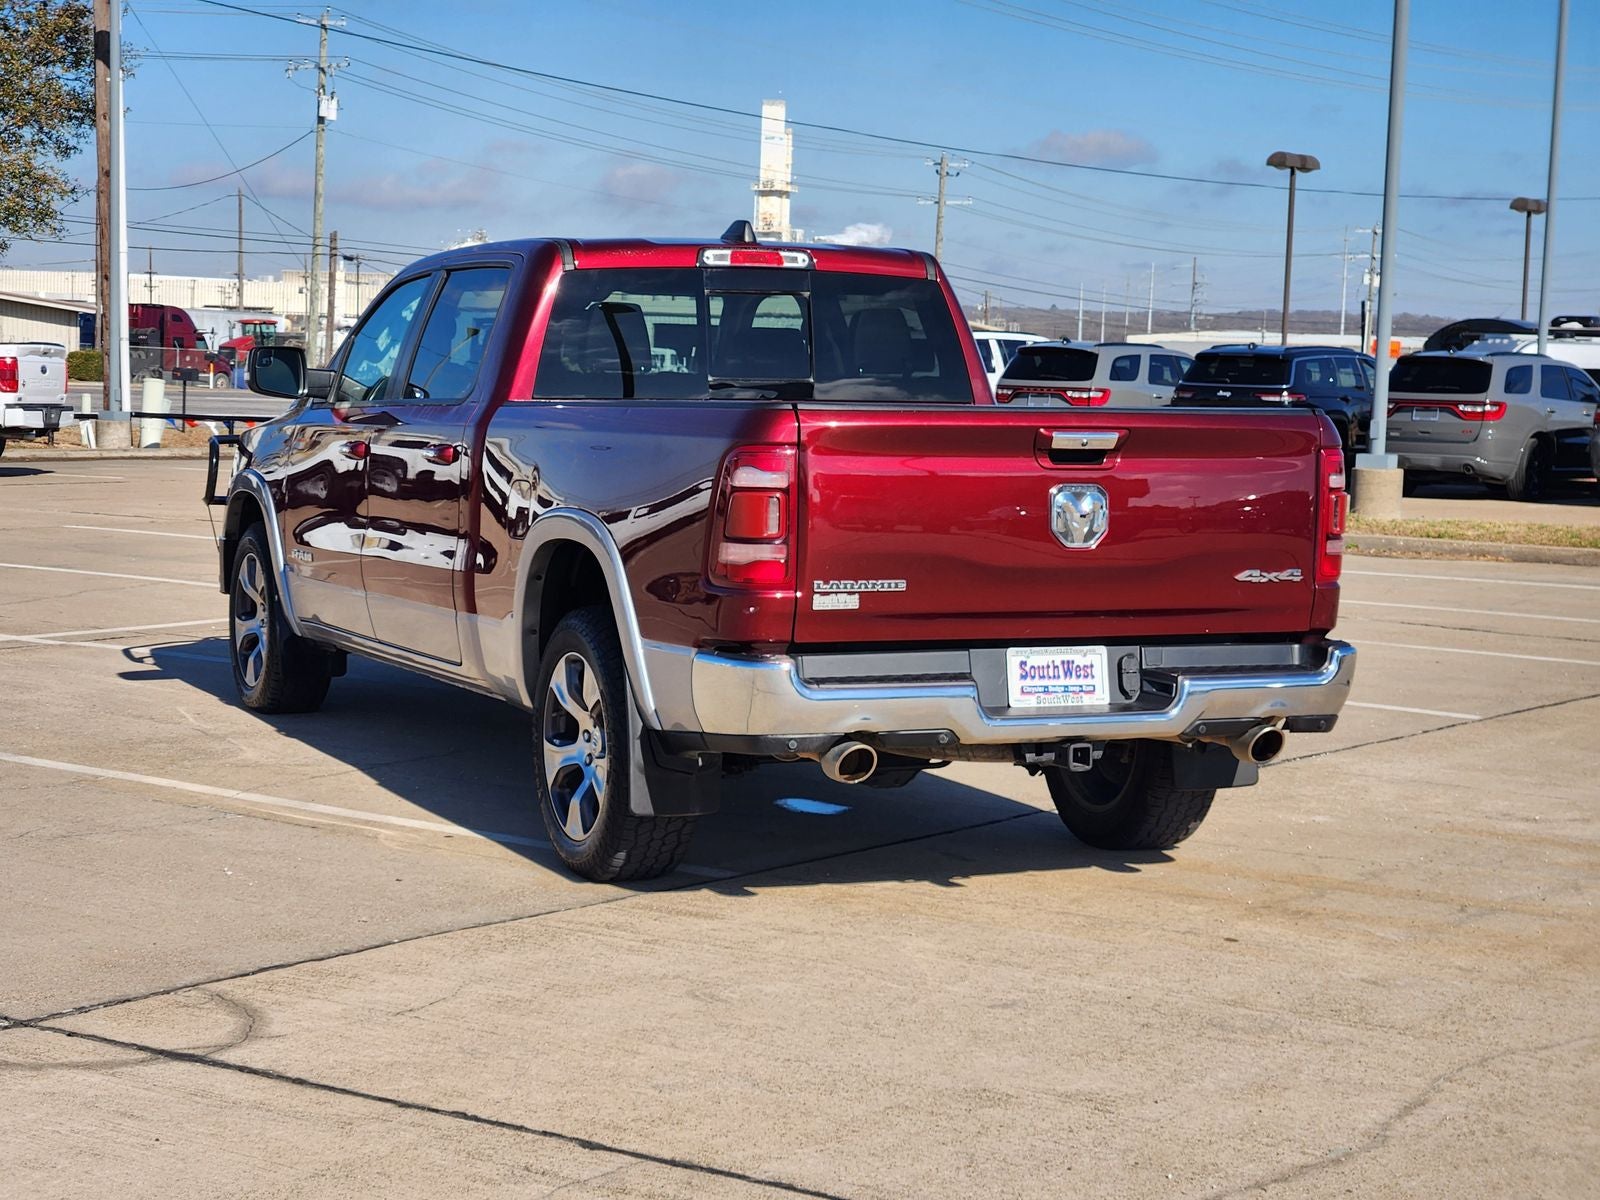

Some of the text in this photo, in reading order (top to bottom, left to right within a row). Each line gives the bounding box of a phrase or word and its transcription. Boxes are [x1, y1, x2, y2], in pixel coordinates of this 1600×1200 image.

[813, 579, 907, 592] LARAMIE
[1018, 659, 1096, 681] SouthWest
[1036, 694, 1085, 705] SouthWest
